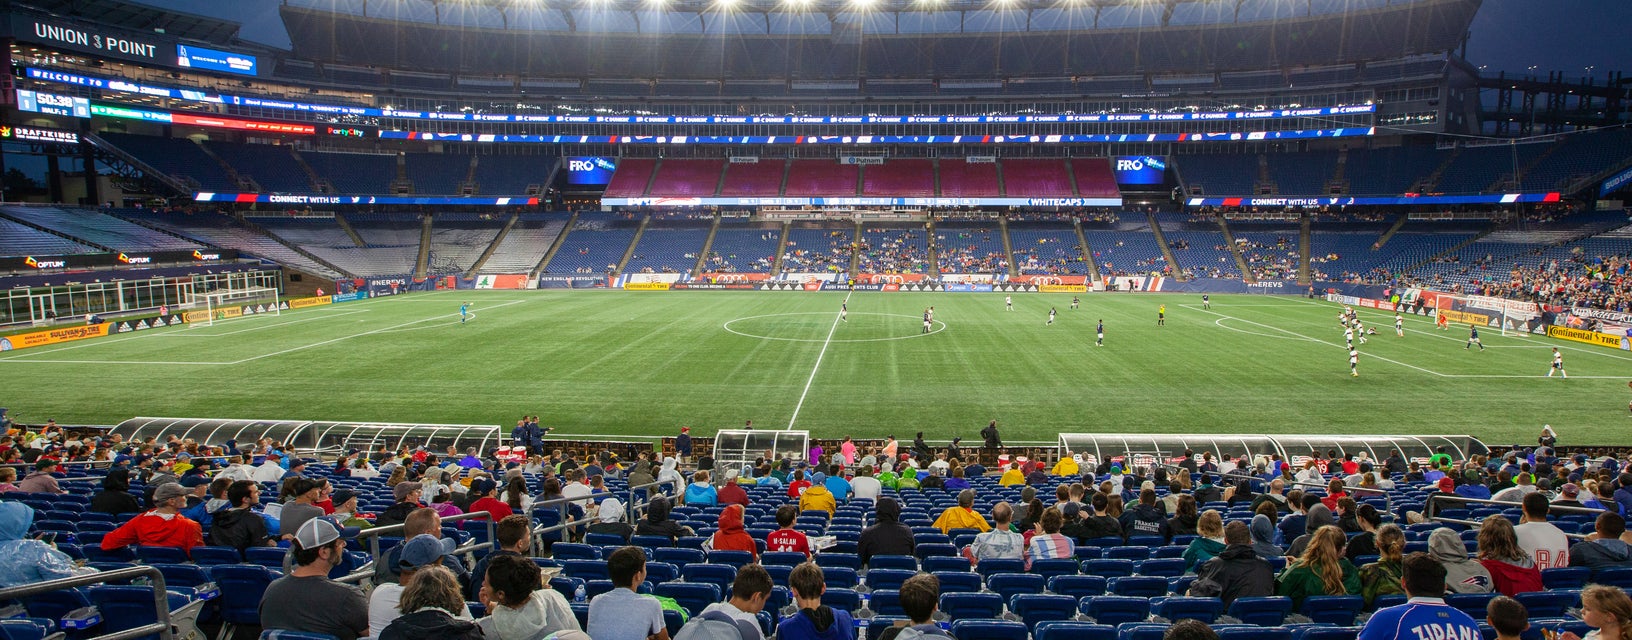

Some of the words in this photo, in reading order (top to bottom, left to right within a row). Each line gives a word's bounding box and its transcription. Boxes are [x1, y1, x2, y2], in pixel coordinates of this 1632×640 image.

[35, 22, 88, 46] UNION
[106, 38, 156, 58] POINT
[33, 70, 84, 84] WELCOME
[15, 128, 77, 140] DRAFTKINGS
[570, 160, 595, 171] FRO
[1117, 160, 1143, 170] FRO
[50, 329, 78, 338] SULLIVAN
[1550, 327, 1592, 340] Continental
[1602, 336, 1620, 345] TIRE
[1317, 463, 1327, 473] 19
[1535, 549, 1566, 570] 84
